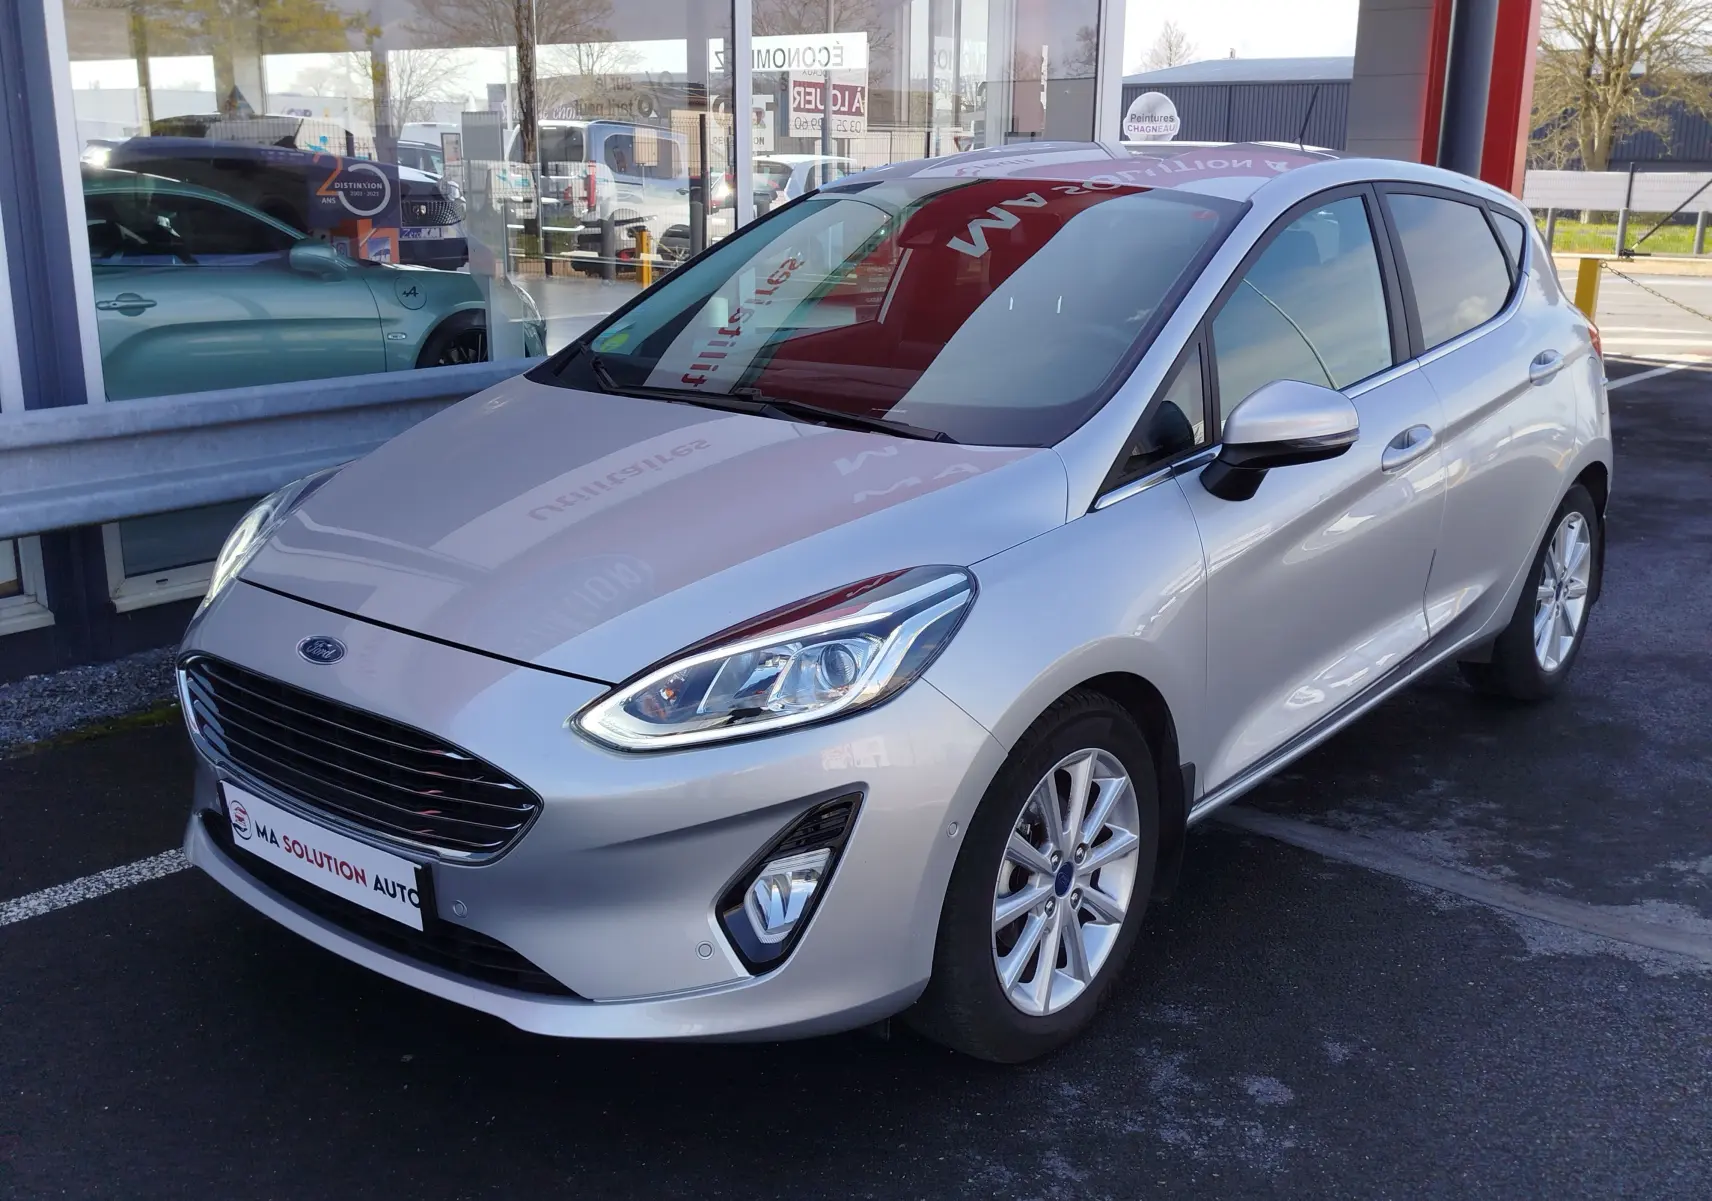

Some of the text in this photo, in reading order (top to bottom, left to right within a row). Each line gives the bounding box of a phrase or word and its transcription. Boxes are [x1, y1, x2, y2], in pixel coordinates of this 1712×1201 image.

[1130, 113, 1174, 123] Peintures
[1127, 124, 1175, 133] CHAGNEAU
[305, 640, 337, 660] Ford
[254, 820, 422, 909] MA SOLUTION AUTO
